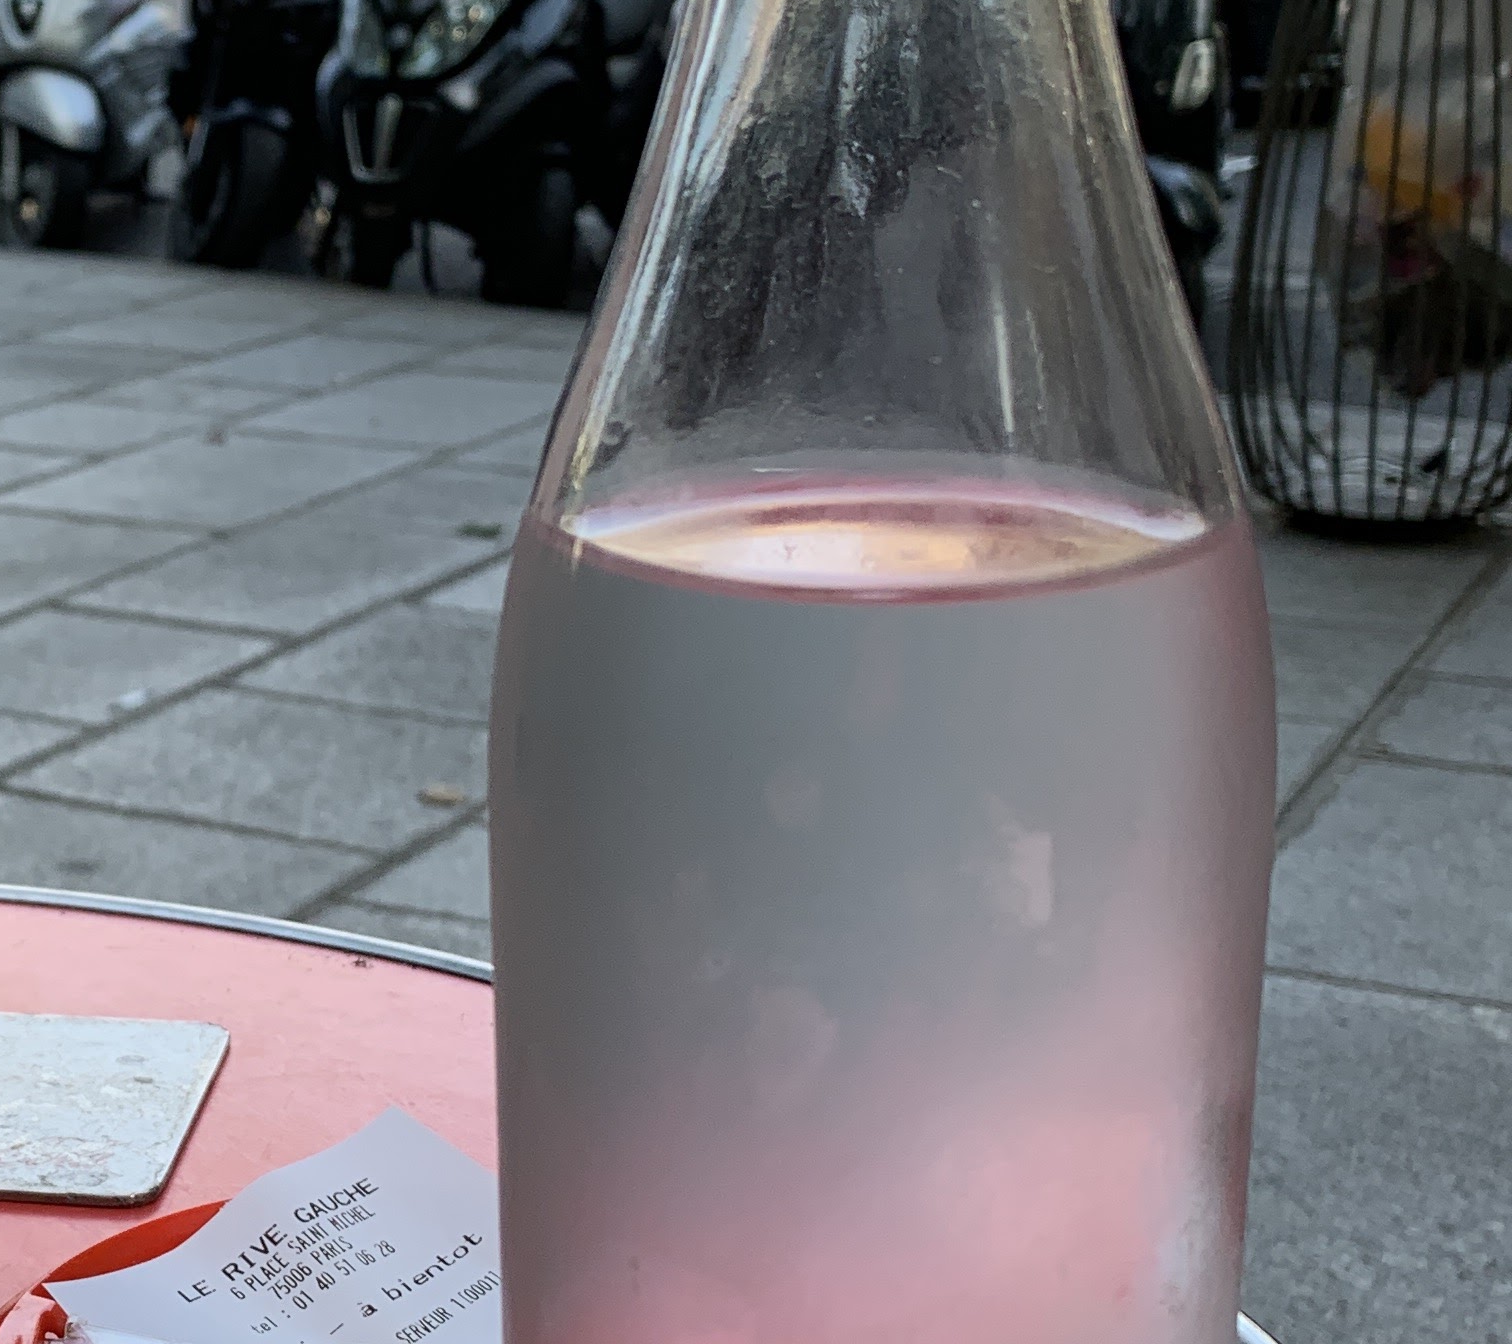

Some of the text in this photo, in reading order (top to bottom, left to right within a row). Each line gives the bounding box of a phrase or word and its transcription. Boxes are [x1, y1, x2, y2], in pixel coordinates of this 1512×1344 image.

[177, 1177, 380, 1303] LE RIVE GAUCHE
[230, 1204, 376, 1300] 6 PLACE SAINT MICHEL
[267, 1235, 354, 1300] 75006 PARIS
[381, 1233, 483, 1301] bientot
[250, 1316, 278, 1334] tel
[292, 1290, 315, 1310] 01
[315, 1271, 336, 1291] 40
[333, 1258, 357, 1276] 51
[354, 1249, 377, 1266] 06
[373, 1240, 396, 1257] 28
[395, 1306, 454, 1344] SERVEUR
